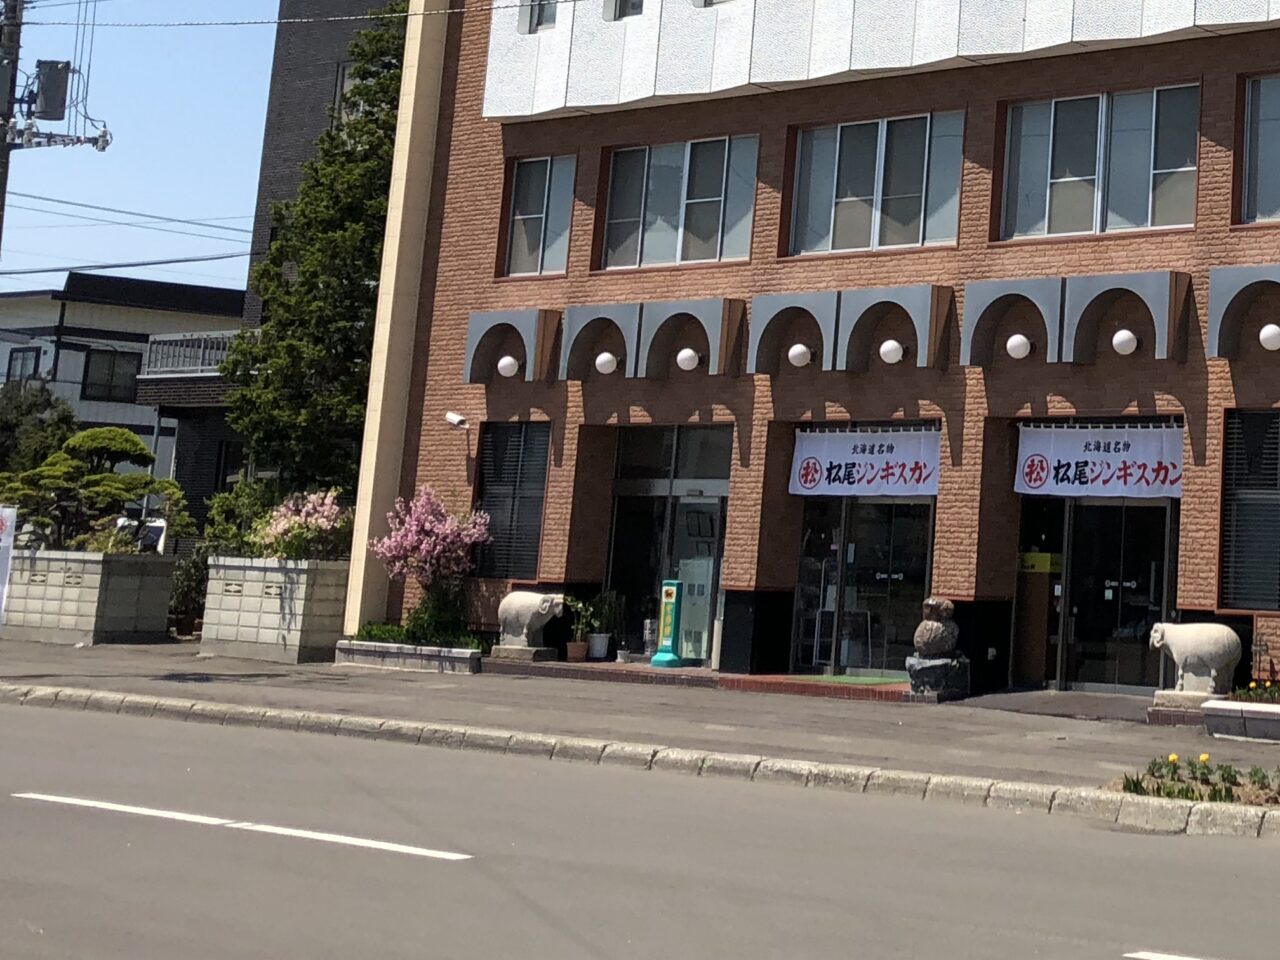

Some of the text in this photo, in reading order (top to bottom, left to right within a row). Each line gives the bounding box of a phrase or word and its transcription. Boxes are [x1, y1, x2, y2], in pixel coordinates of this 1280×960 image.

[851, 443, 895, 455] 北海道名物
[1083, 440, 1131, 453] 北海道名物
